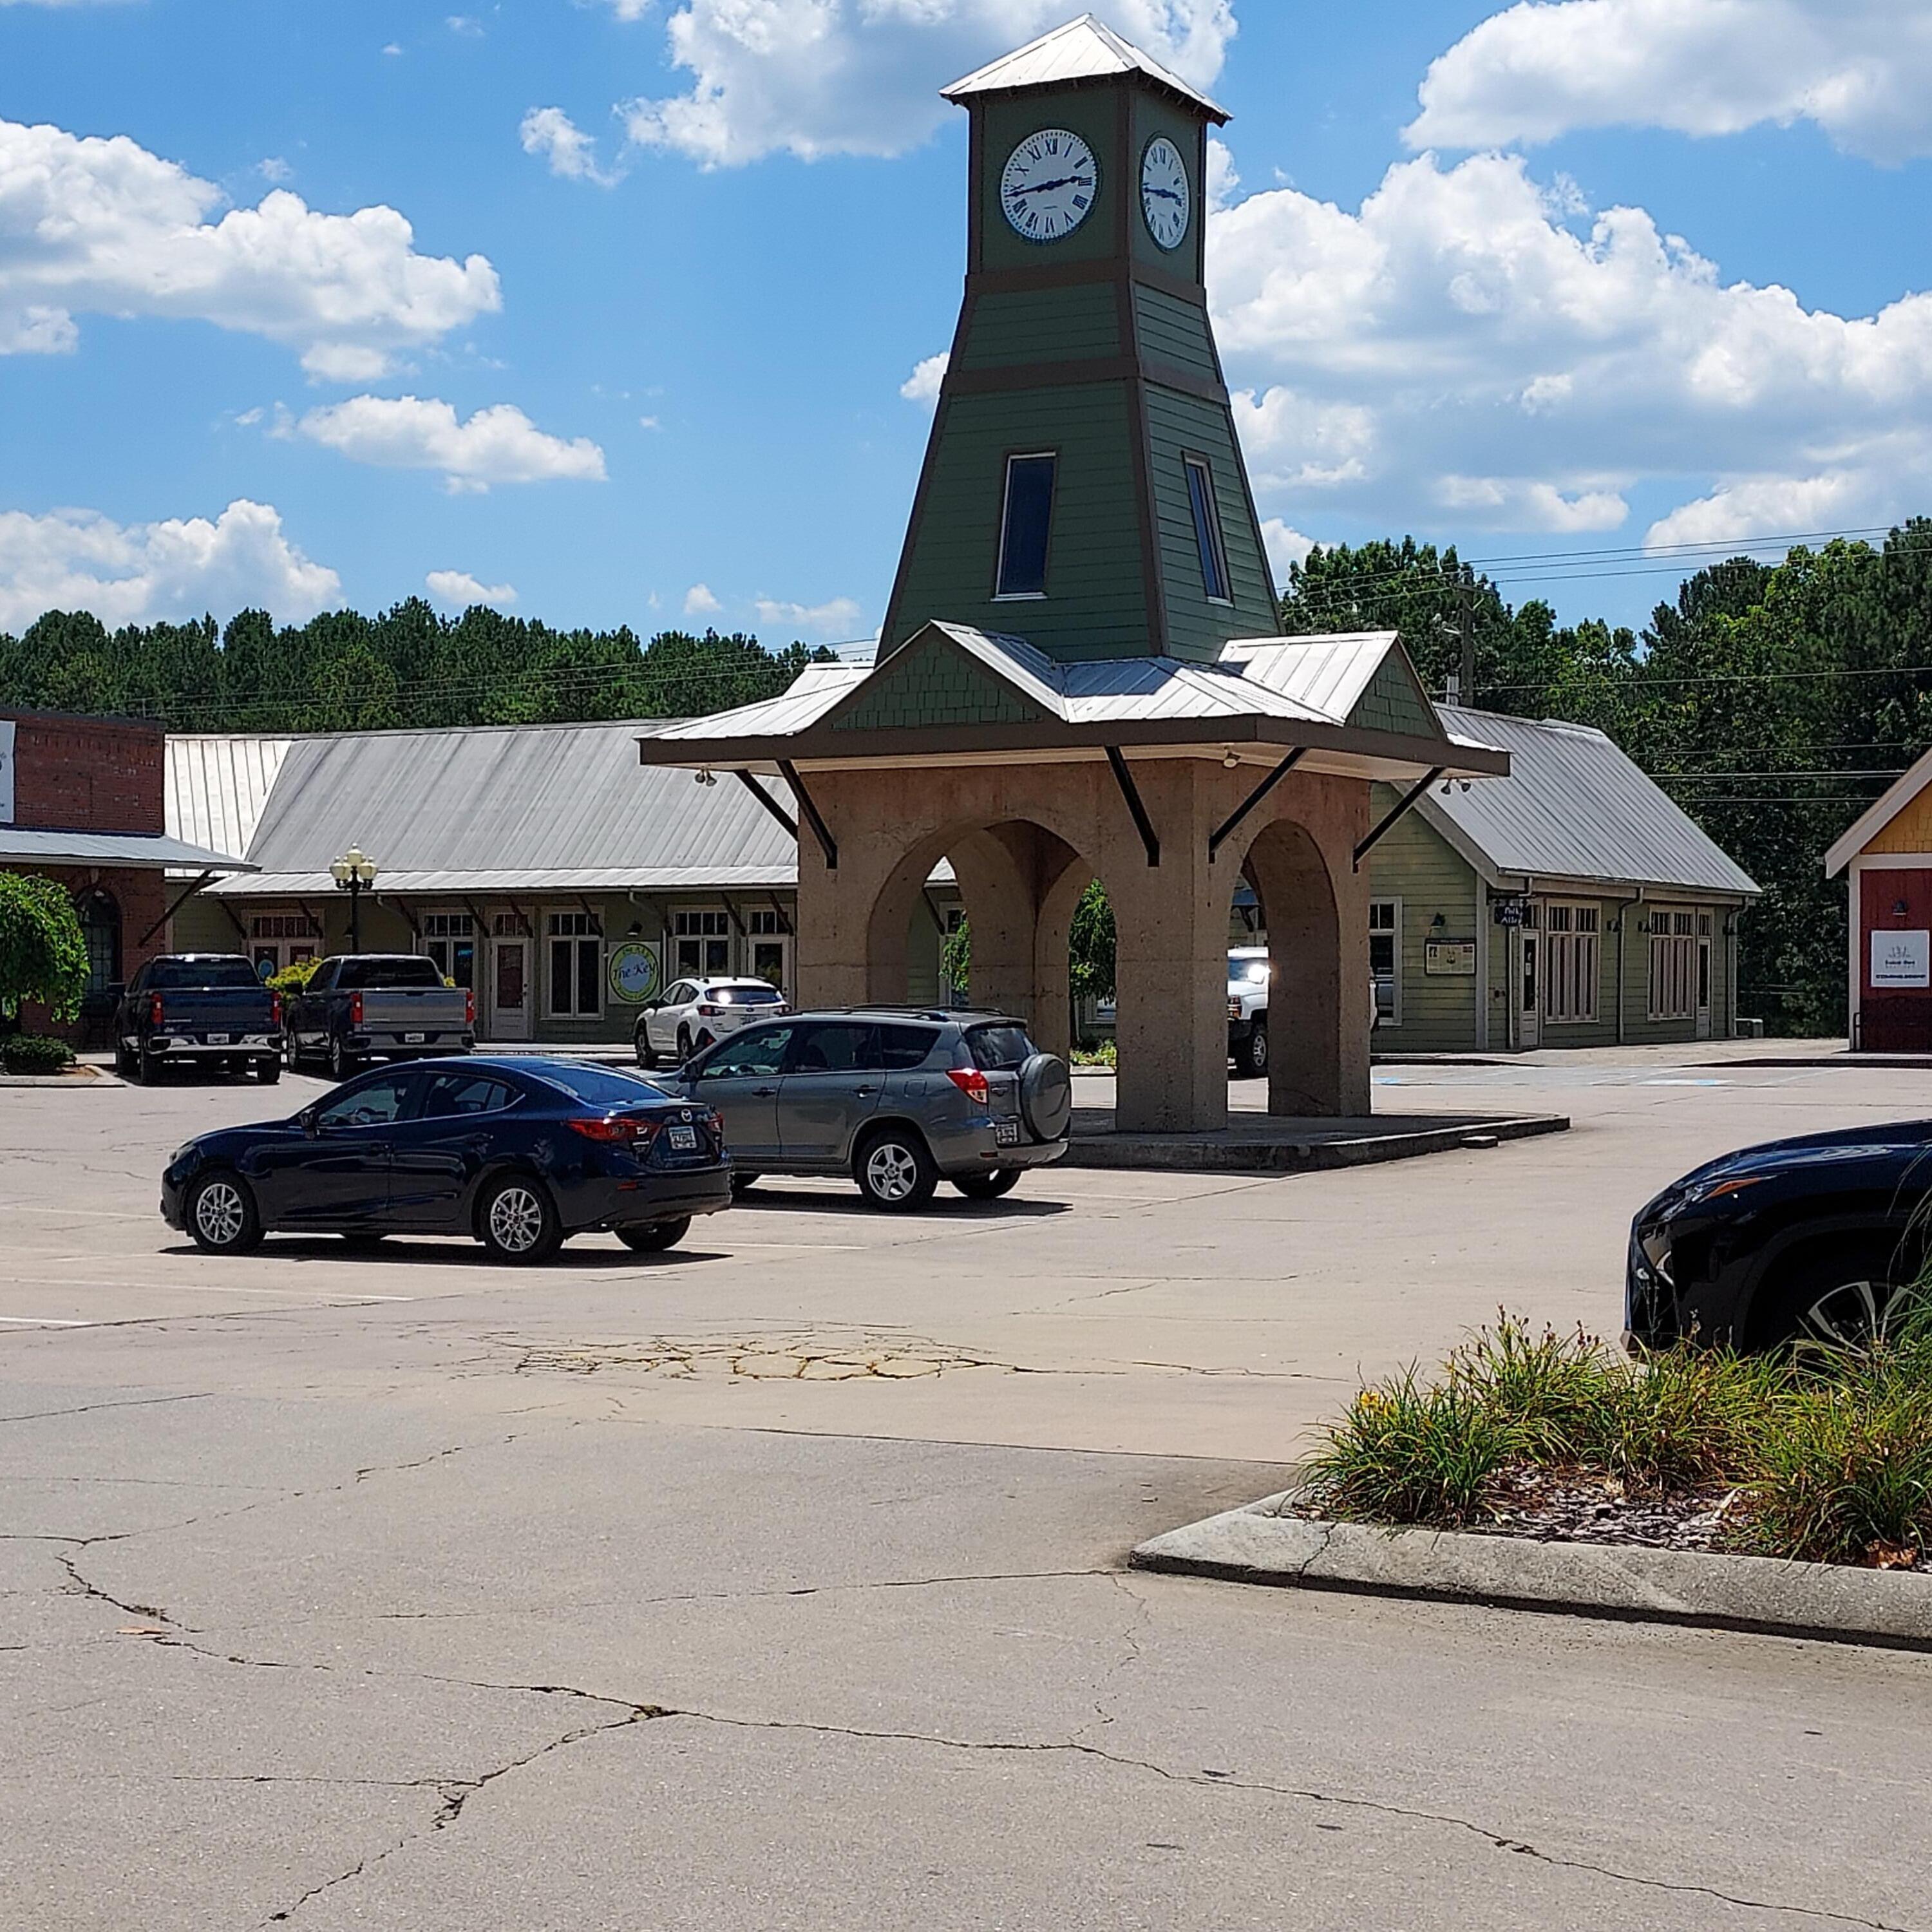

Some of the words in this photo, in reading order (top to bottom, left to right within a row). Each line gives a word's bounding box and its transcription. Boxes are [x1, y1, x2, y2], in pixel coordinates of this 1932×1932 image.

[1027, 144, 1042, 165] XI
[1045, 138, 1058, 156] XII
[1064, 142, 1074, 159] I
[1014, 163, 1030, 176] X
[1074, 156, 1089, 170] II
[1063, 211, 1074, 227] V
[613, 967, 631, 980] The
[633, 961, 656, 977] Key
